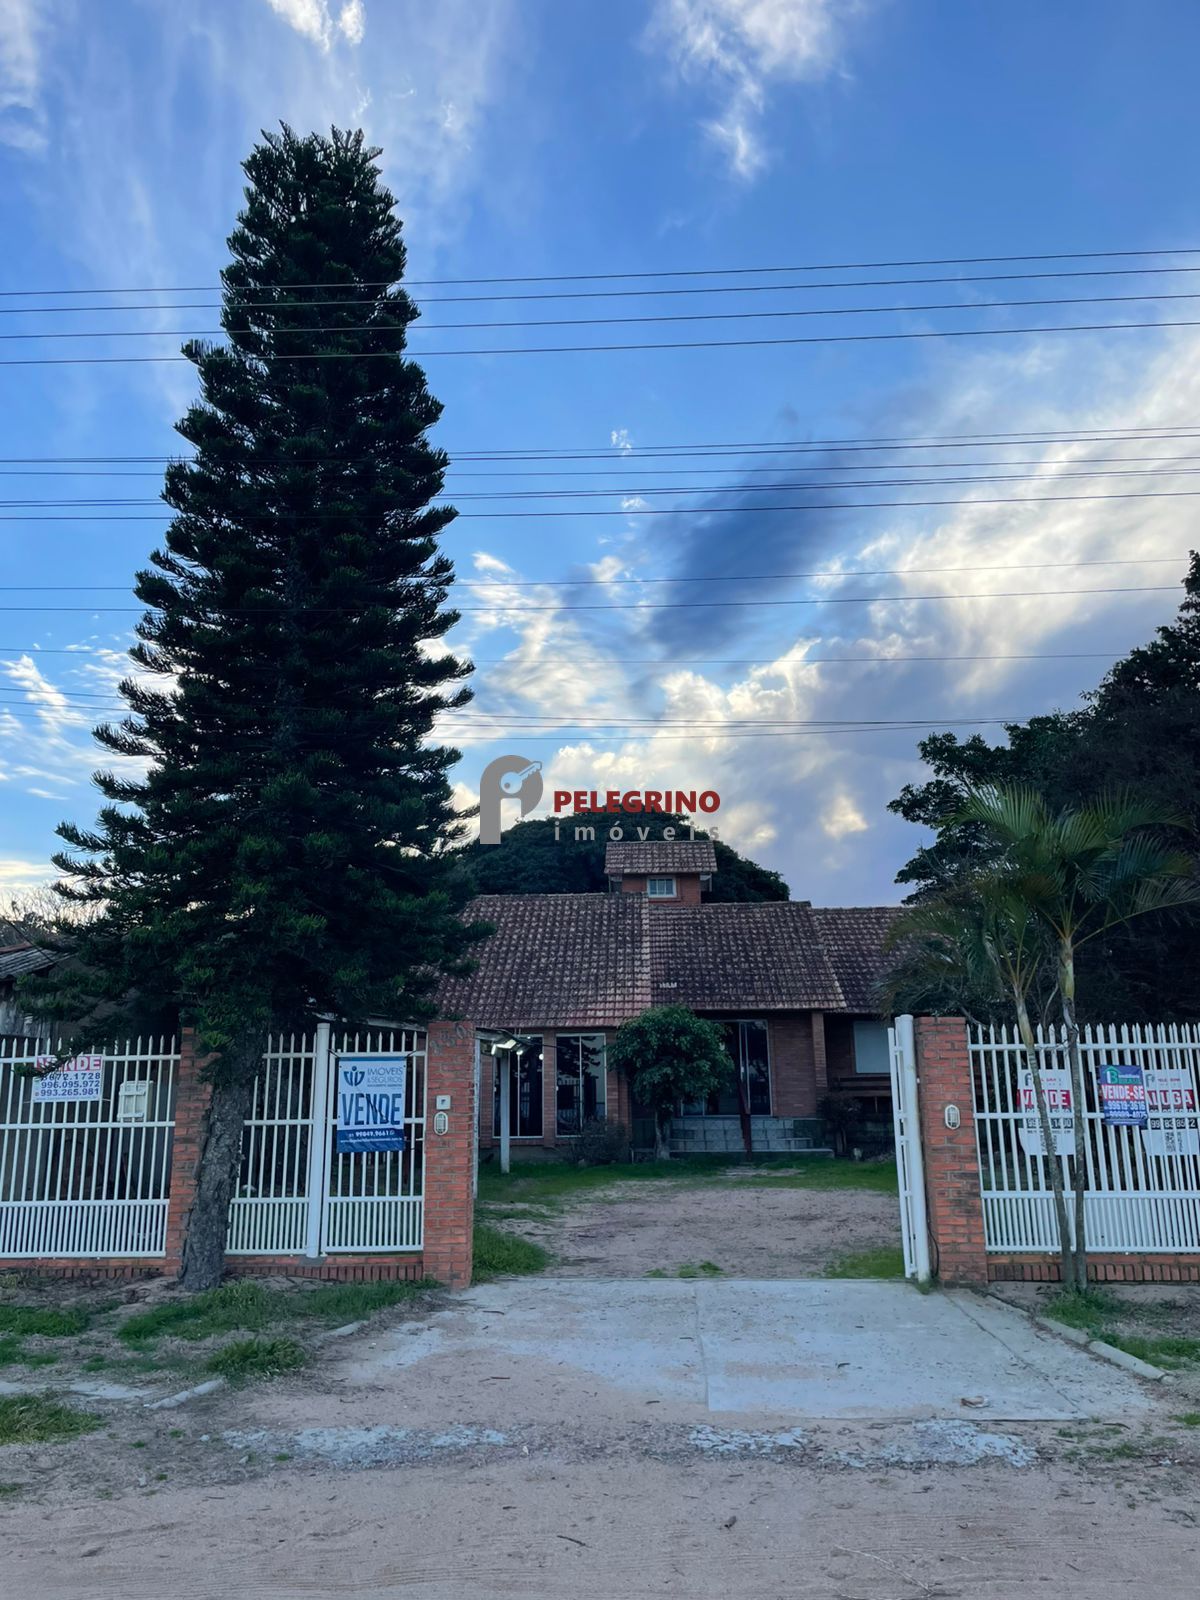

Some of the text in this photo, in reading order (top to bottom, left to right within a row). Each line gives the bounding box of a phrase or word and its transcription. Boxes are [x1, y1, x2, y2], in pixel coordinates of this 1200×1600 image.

[41, 1080, 100, 1089] 996.095.972
[40, 1088, 99, 1097] 993.265.981
[1101, 1084, 1145, 1100] VENDE-SE
[342, 1092, 402, 1126] VENDE
